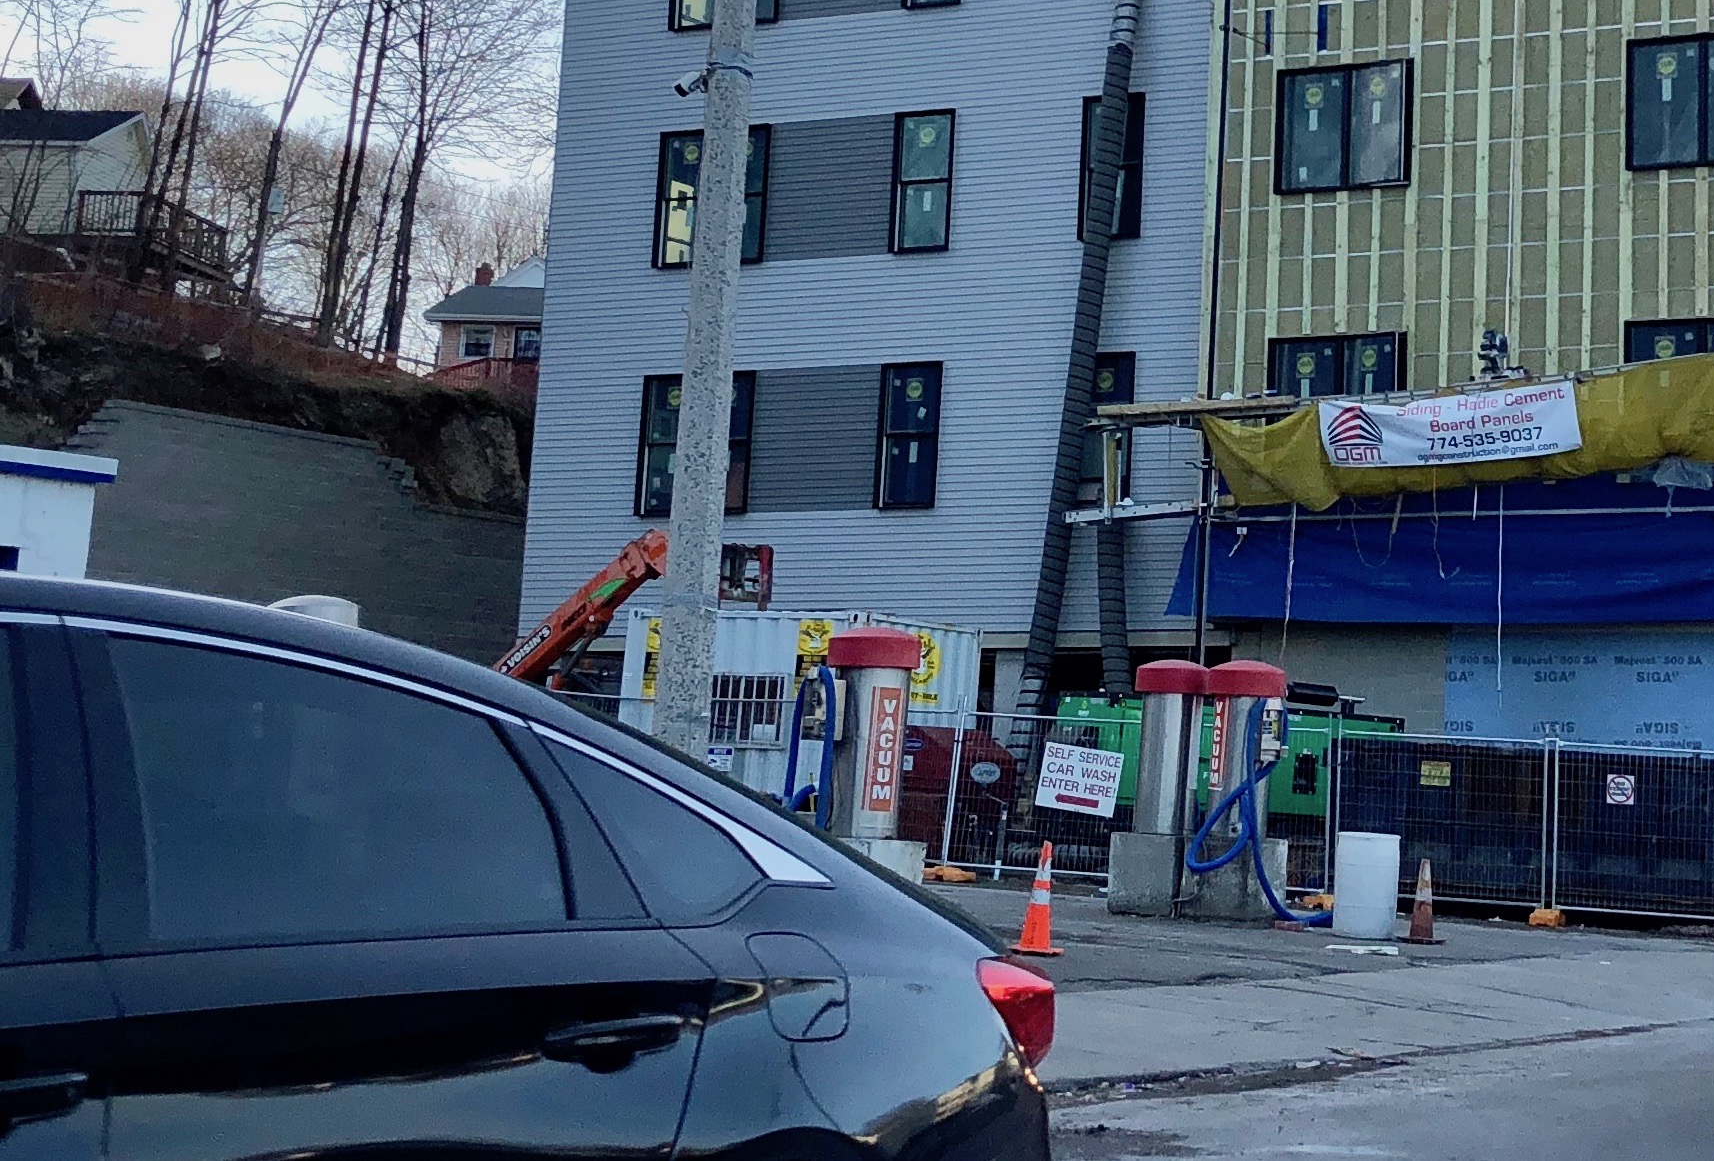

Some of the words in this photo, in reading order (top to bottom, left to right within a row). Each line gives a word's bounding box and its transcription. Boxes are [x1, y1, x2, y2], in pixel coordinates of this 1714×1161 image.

[1397, 405, 1442, 418] Siding
[1504, 388, 1565, 406] Cement
[1430, 416, 1476, 432] Board
[1481, 410, 1534, 427] Panels
[1426, 427, 1542, 450] 774-535-9037
[1333, 446, 1382, 462] OGM
[506, 626, 551, 668] VOISIN'S
[1663, 655, 1684, 665] 500
[1534, 670, 1569, 683] SIGA
[1636, 671, 1672, 683] SIGA
[1643, 721, 1679, 734] SIGA
[872, 699, 897, 799] VACUUM
[1209, 701, 1224, 785] VACUUM
[1046, 746, 1075, 760] SELF
[1078, 751, 1122, 768] SERVICE
[1046, 762, 1075, 776] CAR
[1081, 767, 1117, 783] WASH
[1041, 776, 1080, 792] ENTER
[1084, 783, 1117, 798] HERE!
